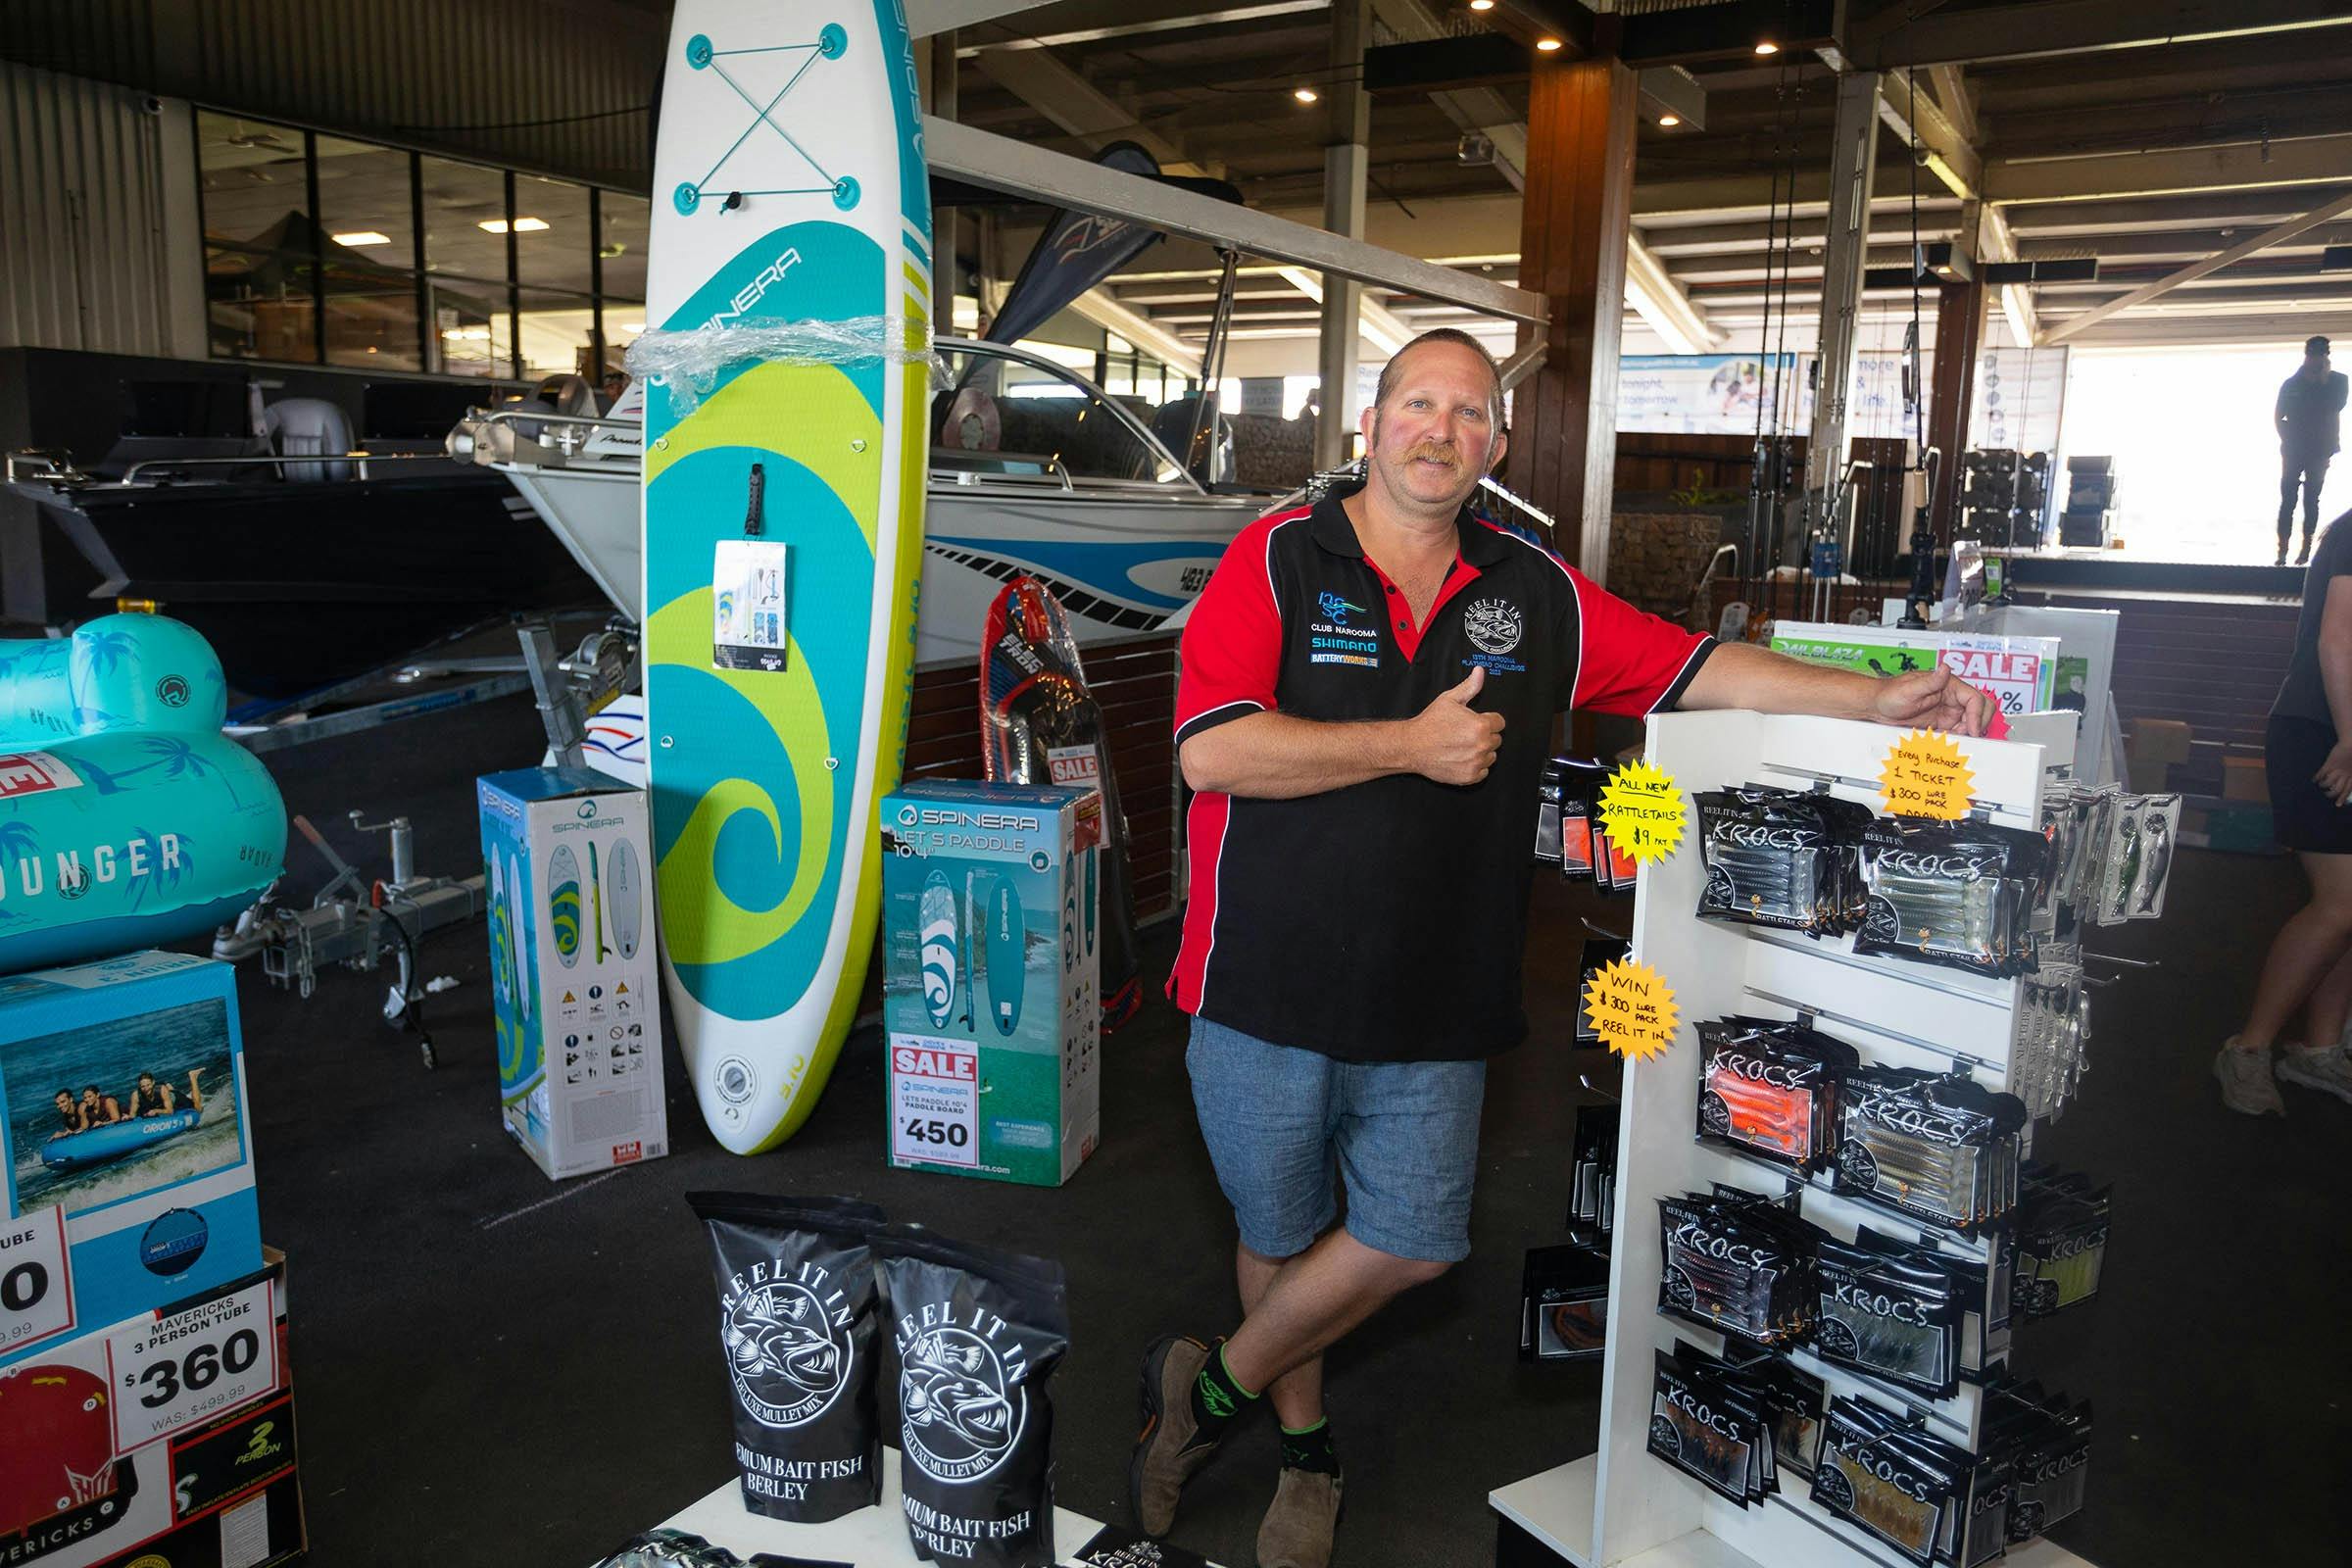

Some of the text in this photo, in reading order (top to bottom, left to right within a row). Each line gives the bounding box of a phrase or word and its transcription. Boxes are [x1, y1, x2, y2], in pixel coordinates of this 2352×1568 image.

[1464, 598, 1521, 620] REEL IT IN
[1311, 623, 1377, 638] CLUB NAROOMA
[1311, 637, 1377, 653] SHIMANO
[1943, 652, 2035, 681] SALE
[1053, 757, 1097, 780] SALE
[1897, 750, 1960, 768] Every Purchase
[1619, 778, 1670, 793] ALL NEW
[1893, 765, 1955, 786] 1 TICKET
[1925, 798, 1948, 809] PACK
[1927, 790, 1947, 800] LURE
[922, 809, 1039, 832] SPINERA
[1607, 803, 1677, 821] RATTLETAILS
[1703, 806, 1723, 816] REEL
[552, 815, 625, 834] SPINERA
[949, 833, 1025, 853] PADDLE
[1864, 832, 1885, 844] REEL
[0, 833, 182, 902] UNGER
[1610, 972, 1649, 997] WIN
[1635, 1012, 1659, 1025] PACK
[1636, 1003, 1657, 1013] LURE
[1602, 1018, 1665, 1041] REEL IT IN
[895, 1049, 974, 1080] SALE
[912, 1083, 968, 1096] SPINERA
[905, 1102, 964, 1114] PADDLE BOARD
[921, 1097, 949, 1106] PADDLE
[906, 1118, 968, 1148] 450
[722, 1258, 854, 1327] REEL IT IN
[133, 1301, 252, 1354] 3 PERSON TUBE
[150, 1296, 235, 1337] MAVERICKS
[969, 1307, 1007, 1341] IT
[1003, 1343, 1028, 1383] IN
[139, 1328, 260, 1409] 360
[151, 1384, 246, 1433] WAS: $499.99
[735, 1377, 824, 1423] DELUXE MULLET MIX
[902, 1421, 994, 1478] DELUXE MULLET MIX
[774, 1457, 816, 1480] BAIT
[819, 1454, 863, 1479] FISH
[747, 1473, 808, 1501] BERLEY
[939, 1514, 983, 1538] BAIT
[988, 1509, 1031, 1538] FISH
[912, 1523, 976, 1559] BRLEY
[1113, 1548, 1138, 1562] REEL
